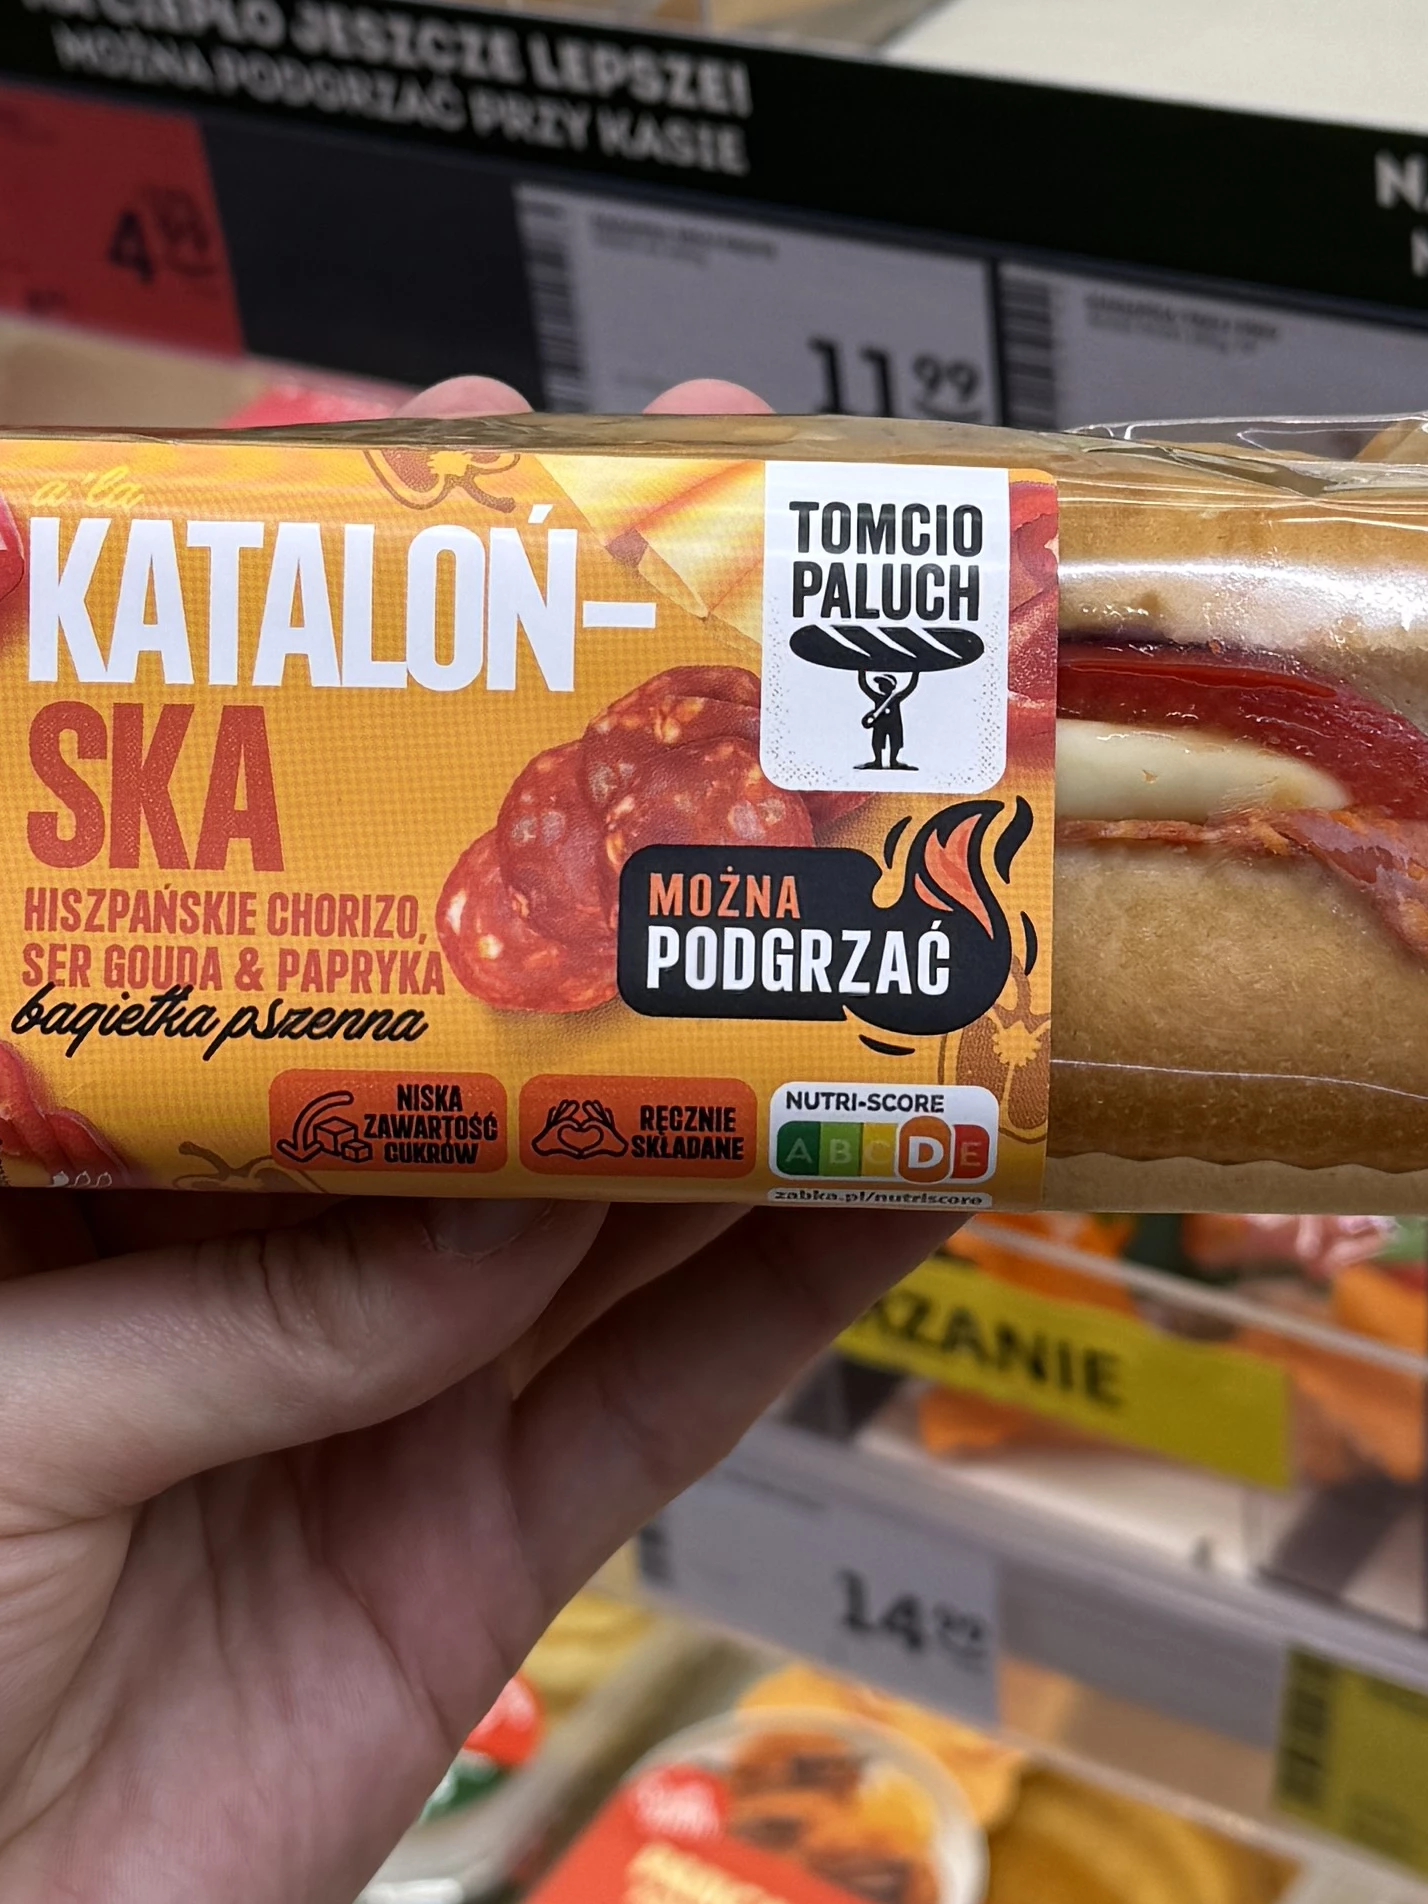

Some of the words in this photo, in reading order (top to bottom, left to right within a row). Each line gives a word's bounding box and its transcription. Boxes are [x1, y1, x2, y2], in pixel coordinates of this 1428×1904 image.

[789, 500, 984, 558] TOMCIO
[28, 504, 656, 694] KATALOŃ-
[792, 560, 980, 622] PALUCH
[26, 700, 286, 872] SKA
[23, 882, 257, 938] HISZPAŃSKIE
[266, 894, 428, 946] CHORIZO,
[648, 864, 802, 920] MOŻNA
[22, 942, 92, 988] SER
[104, 945, 223, 992] GOUDA
[234, 947, 264, 993] &
[277, 950, 445, 996] PAPRYKA
[644, 920, 952, 998] PODGRZAĆ
[10, 982, 222, 1058] bagietka
[202, 998, 428, 1062] pszenna
[396, 1084, 464, 1113] NISKA
[638, 1103, 738, 1138] RĘCZNIE
[785, 1090, 946, 1114] NUTRI-SCORE
[363, 1112, 499, 1142] ZAWARTOŚĆ
[383, 1134, 480, 1166] CUKRÓW
[631, 1134, 746, 1162] SKŁADANE
